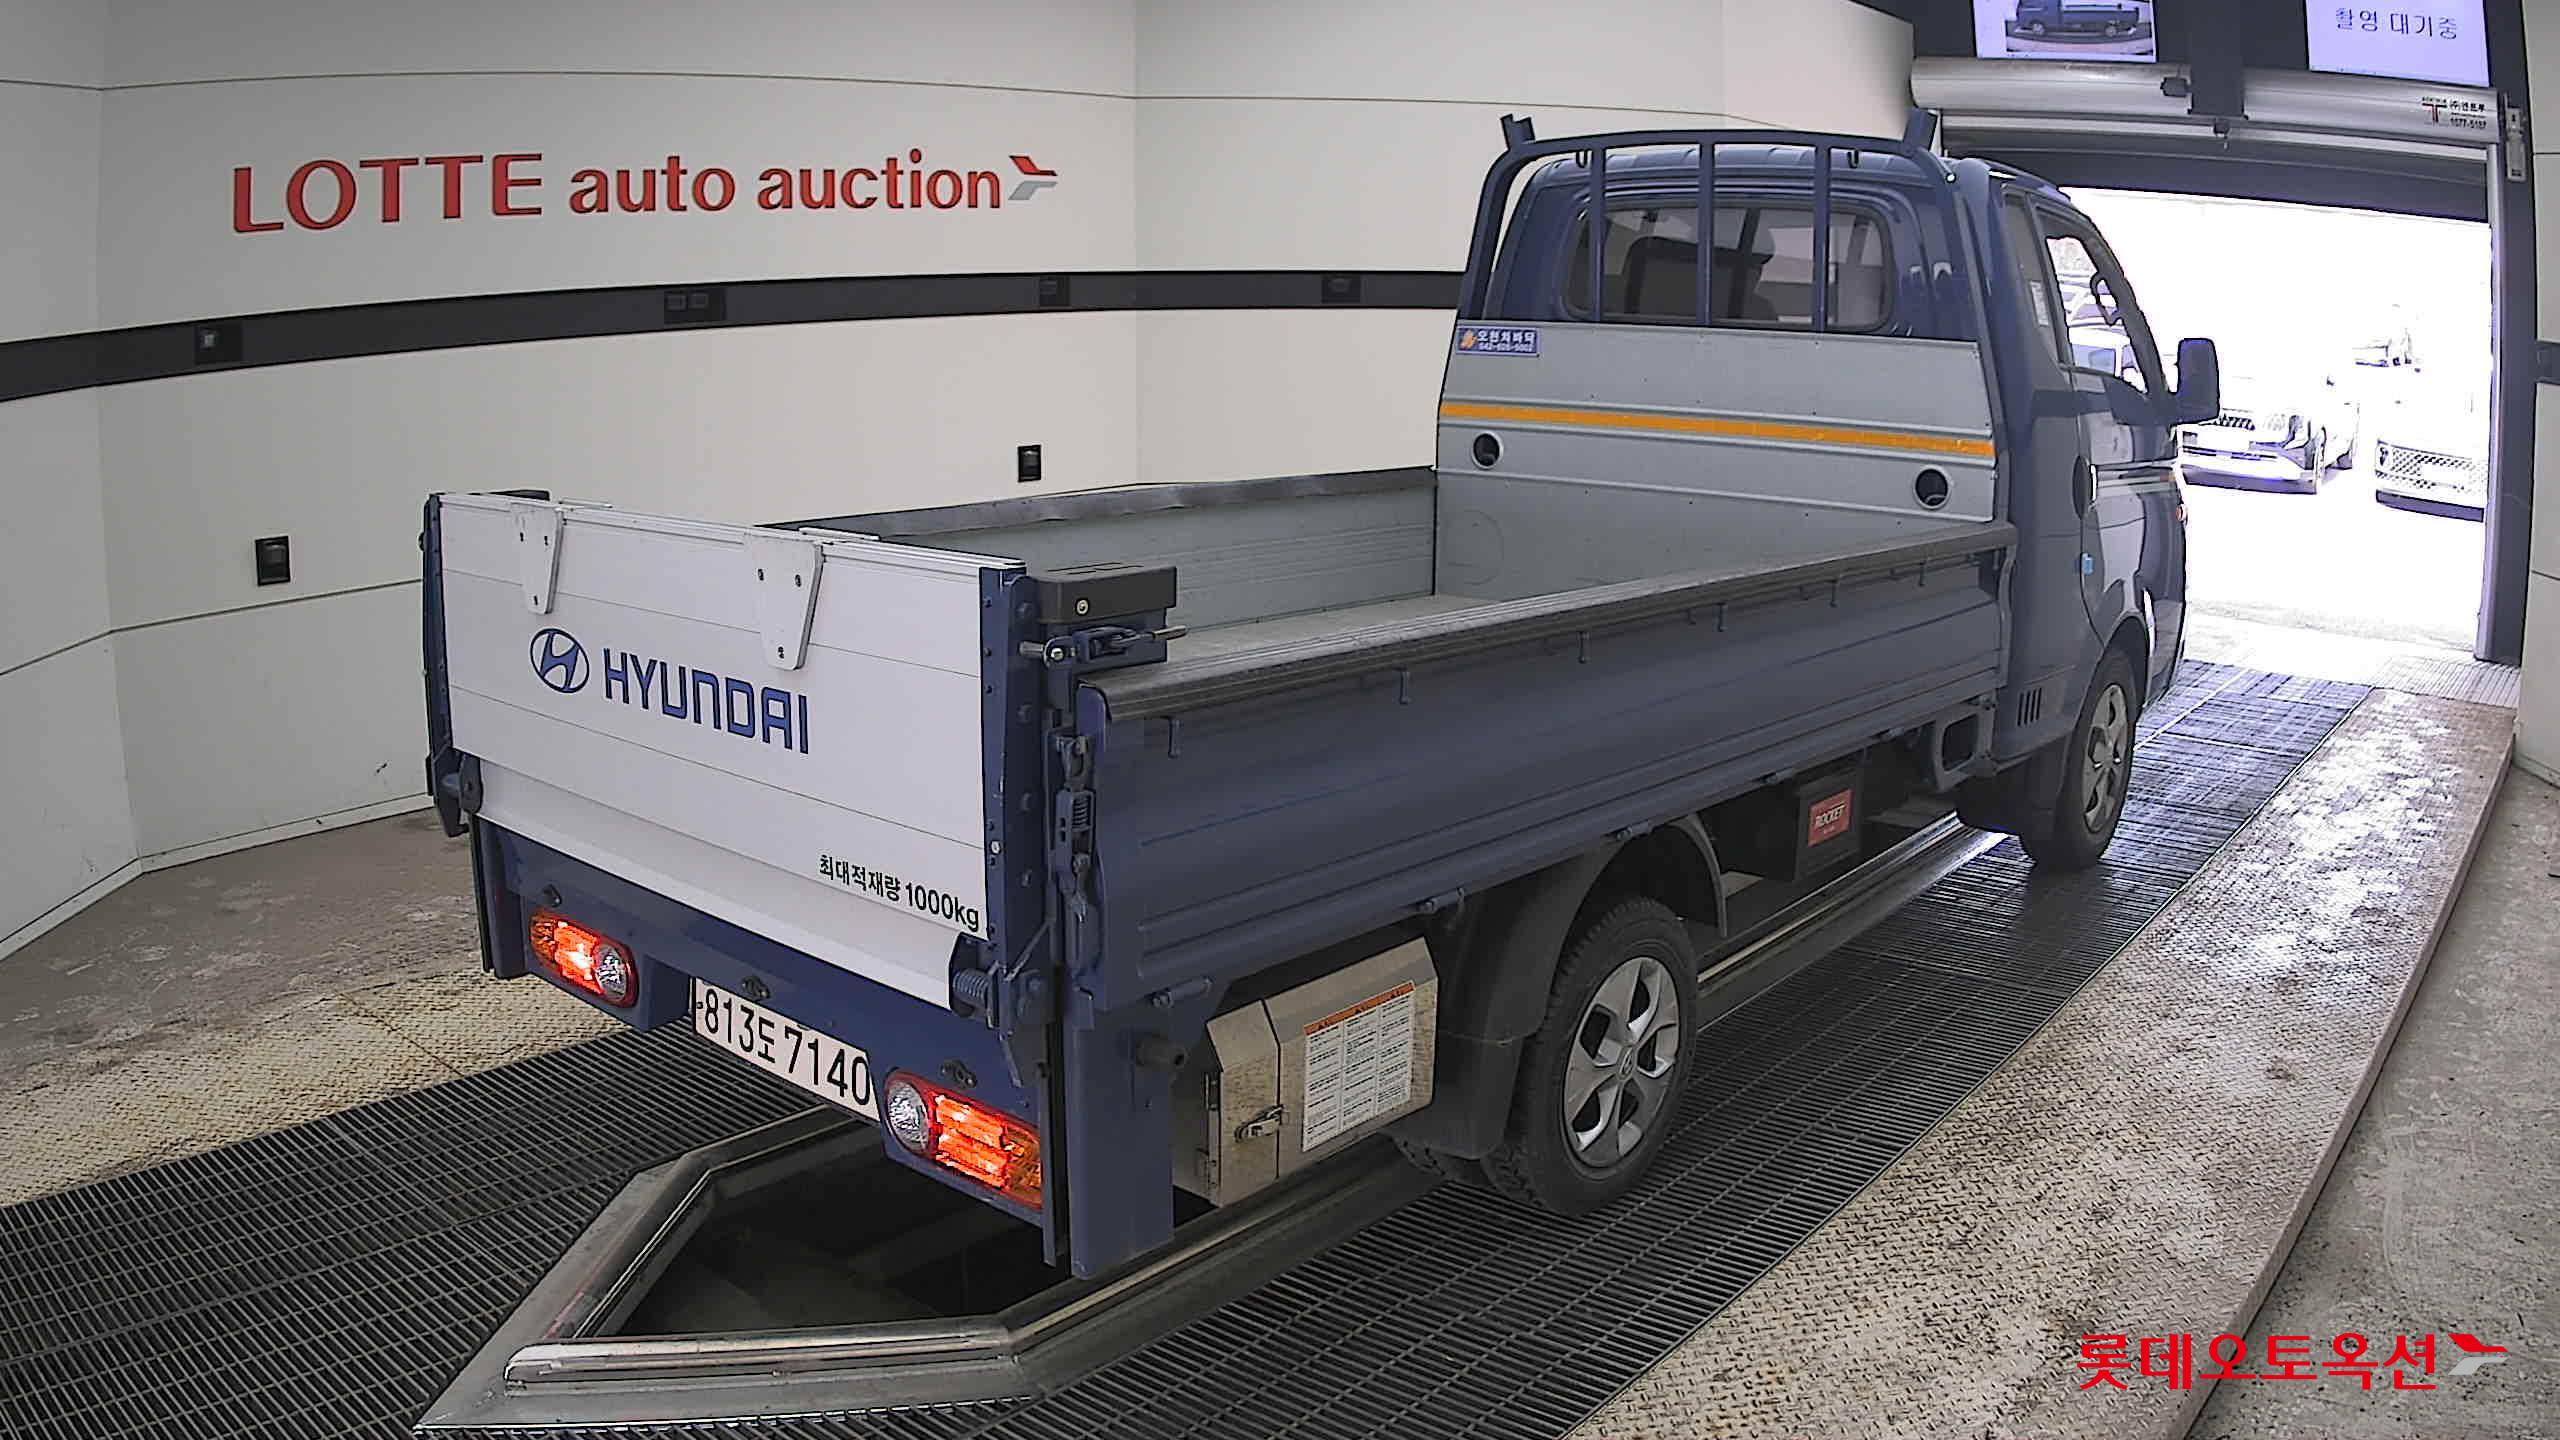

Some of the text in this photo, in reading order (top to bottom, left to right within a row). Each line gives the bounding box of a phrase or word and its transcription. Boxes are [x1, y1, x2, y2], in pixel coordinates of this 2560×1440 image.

[2335, 7, 2457, 40] 촬영 대기중
[233, 147, 1001, 234] LOTTE auto auction
[603, 647, 809, 754] HYUNDAI
[1815, 802, 1846, 827] ROCKET
[819, 854, 979, 932] 최대적재량 1000kg
